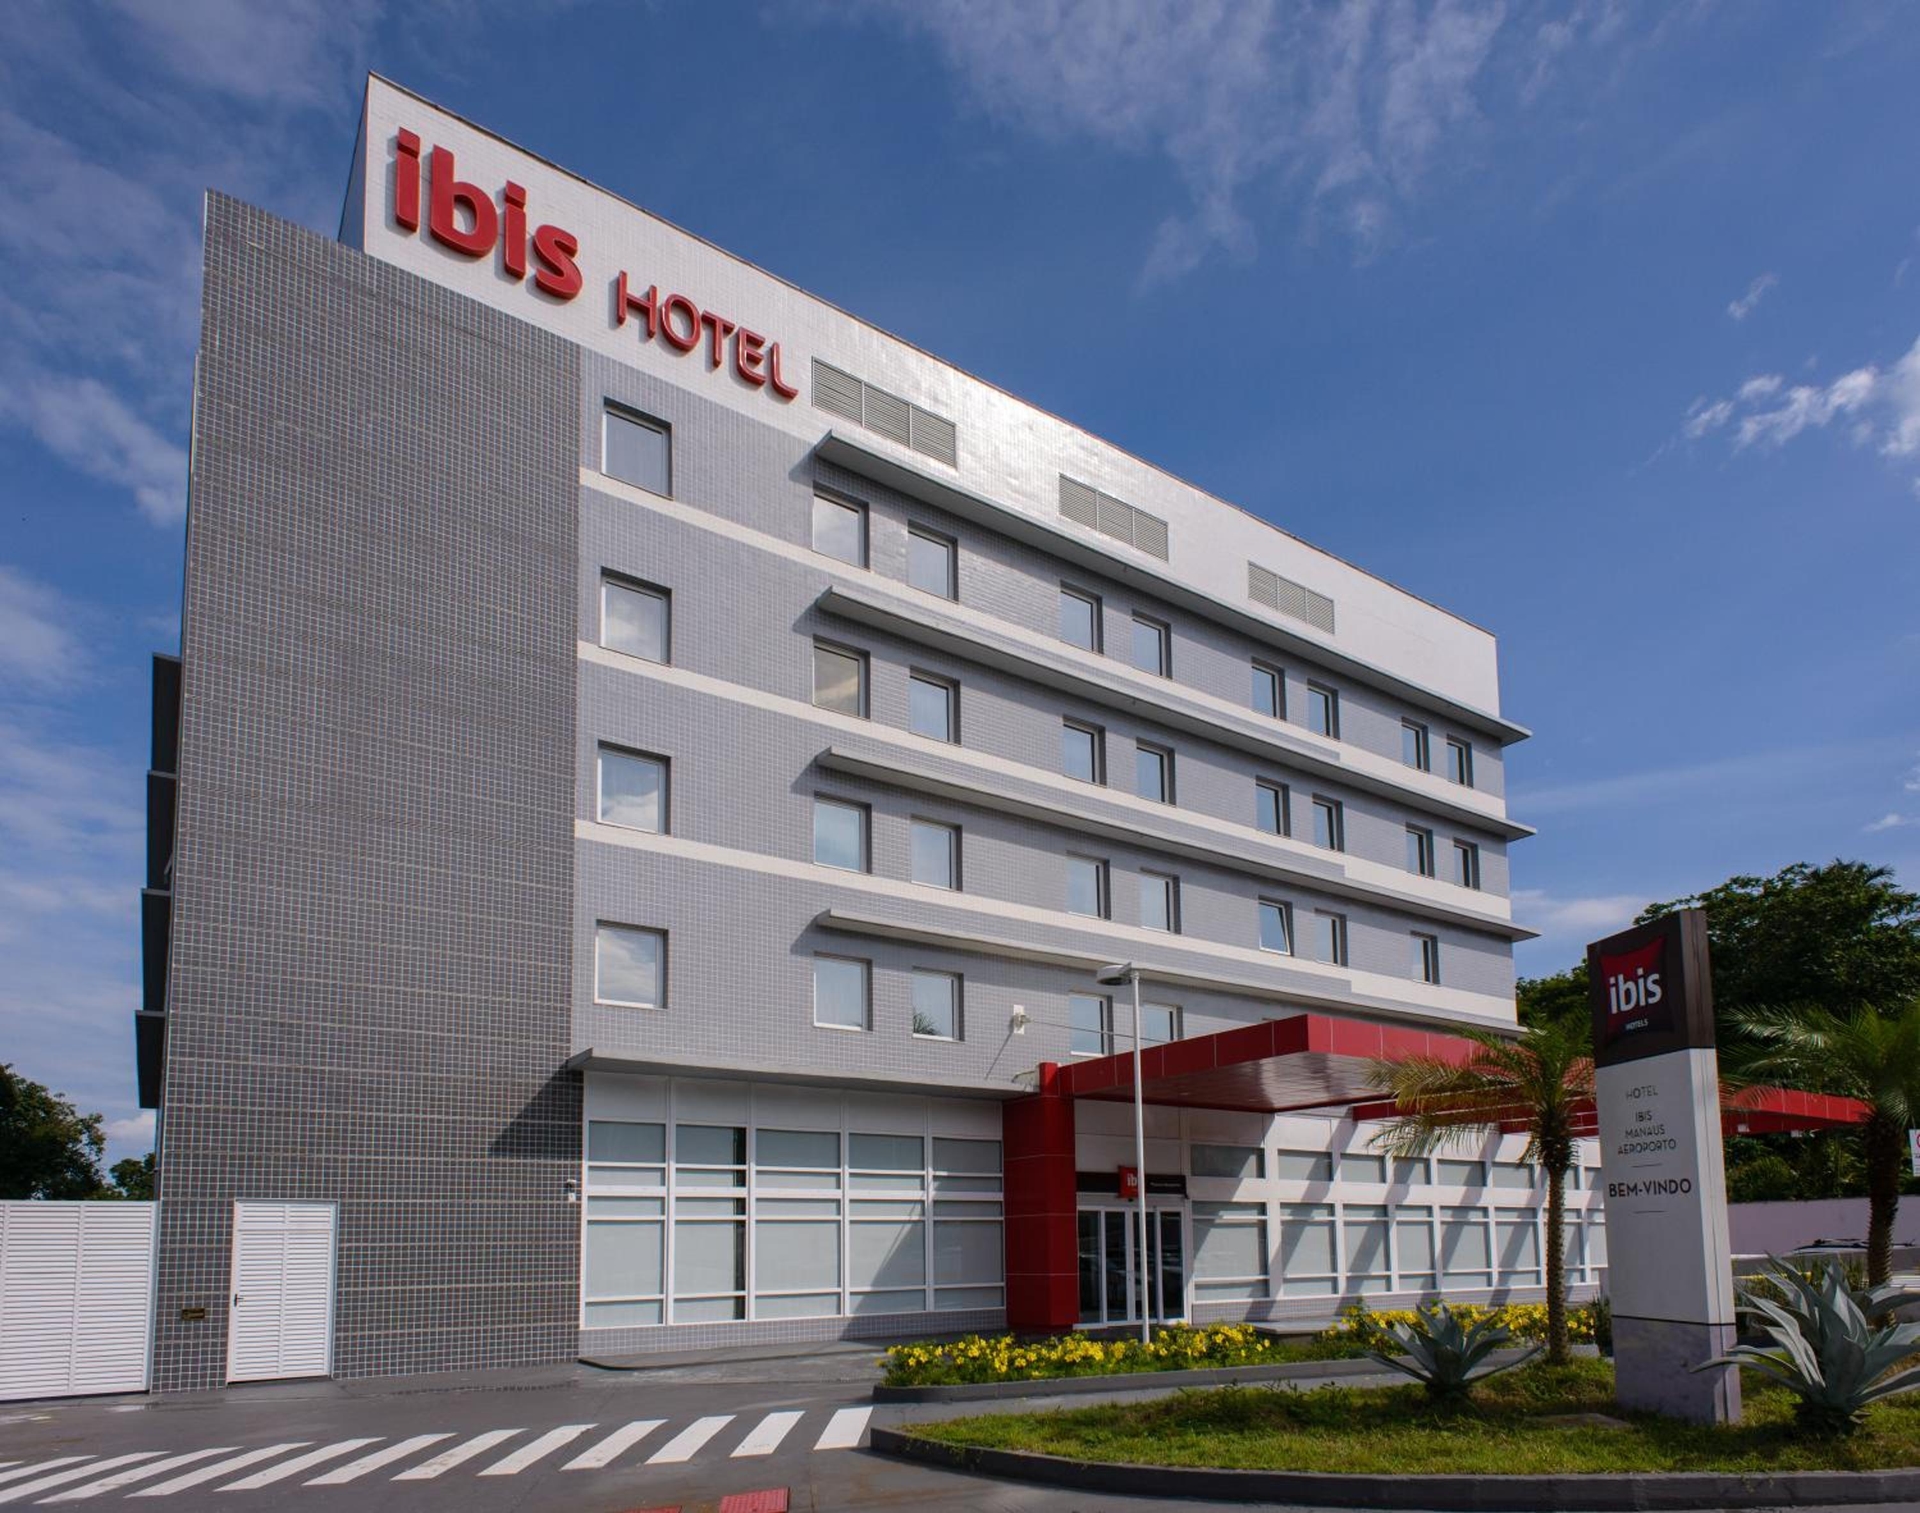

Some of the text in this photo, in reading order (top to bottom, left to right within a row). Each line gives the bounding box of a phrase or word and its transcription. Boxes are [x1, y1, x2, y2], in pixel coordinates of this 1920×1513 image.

[394, 125, 799, 399] ibis HOTEL
[1608, 967, 1663, 1015] ibis
[1625, 1018, 1649, 1031] HOTELS
[1626, 1084, 1659, 1100] HOTEL
[1635, 1110, 1653, 1122] IBIS
[1625, 1124, 1665, 1139] MANAUS
[1617, 1138, 1677, 1155] AEROPORTO
[1608, 1178, 1692, 1198] BEM-VINDO
